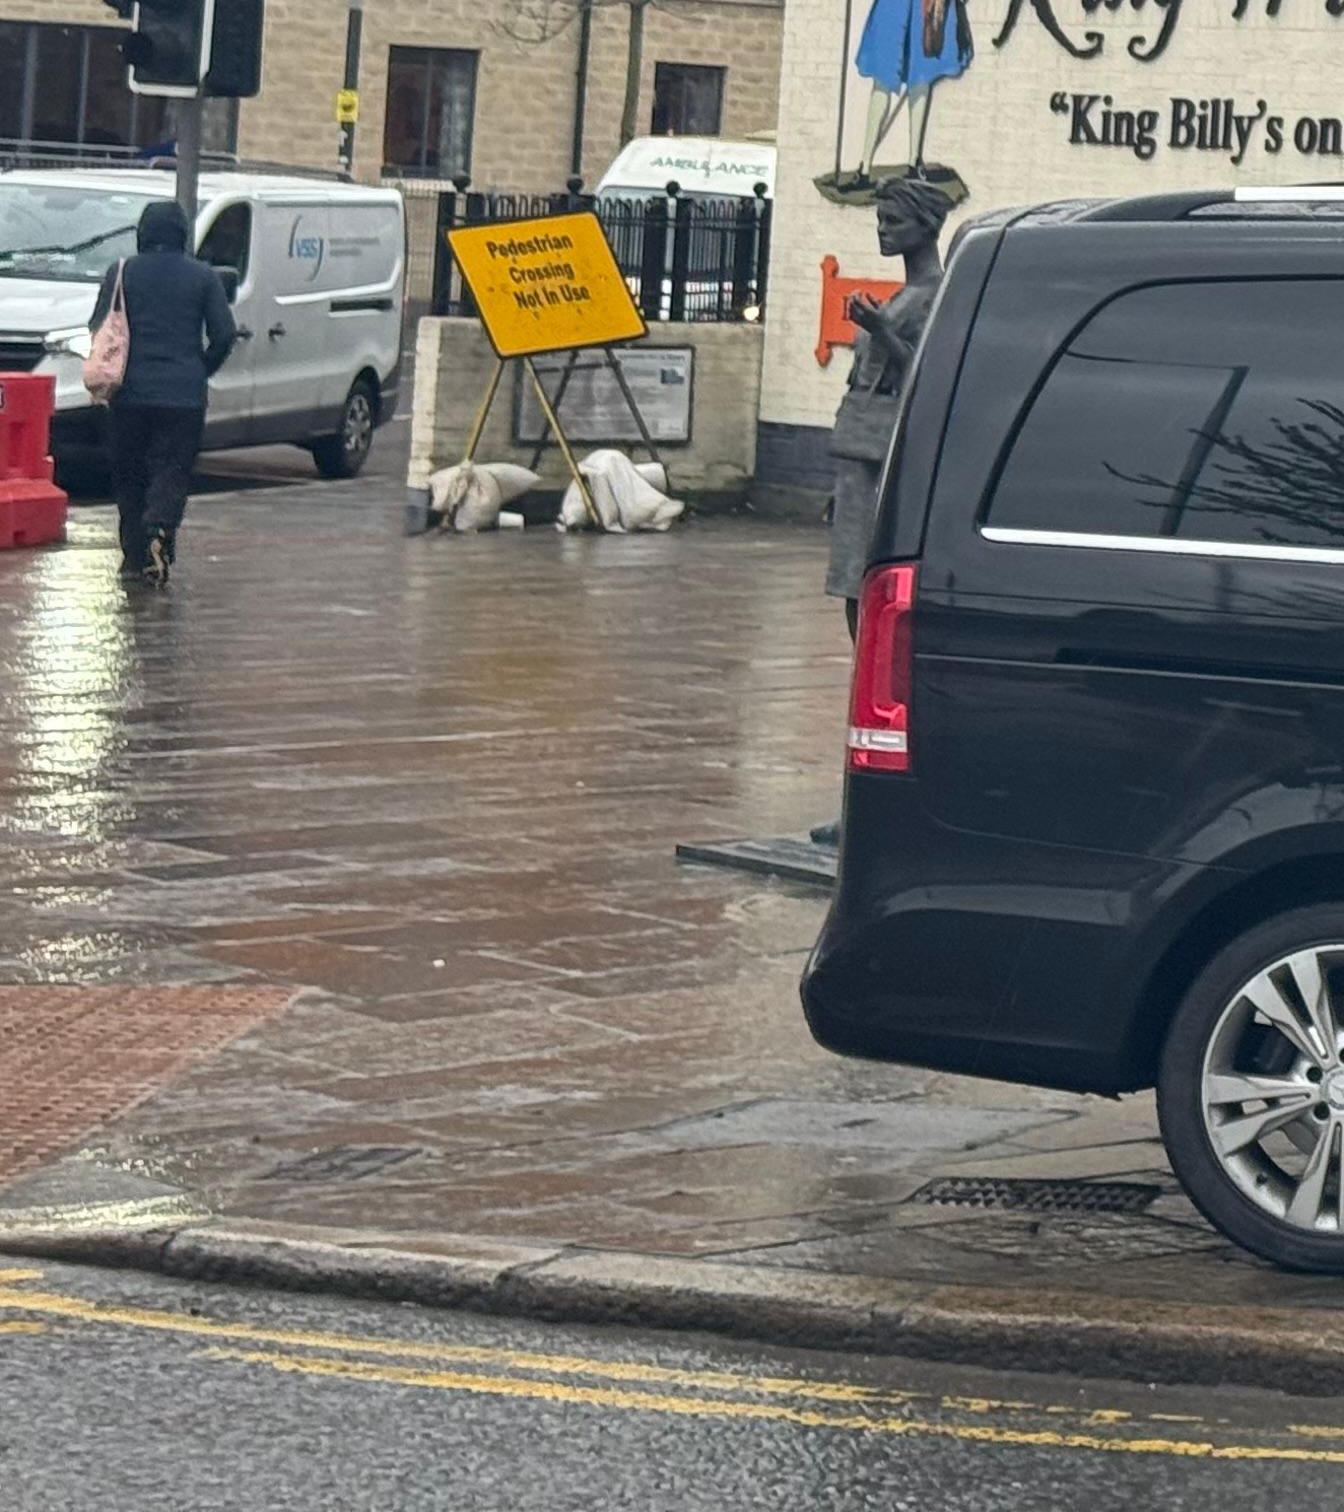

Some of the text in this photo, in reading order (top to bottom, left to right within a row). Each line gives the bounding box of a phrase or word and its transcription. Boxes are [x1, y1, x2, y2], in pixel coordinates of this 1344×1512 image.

[1293, 108, 1344, 154] on
[485, 233, 574, 259] Pedestrian
[509, 261, 575, 284] Crossing
[513, 285, 590, 309] Not In Use
